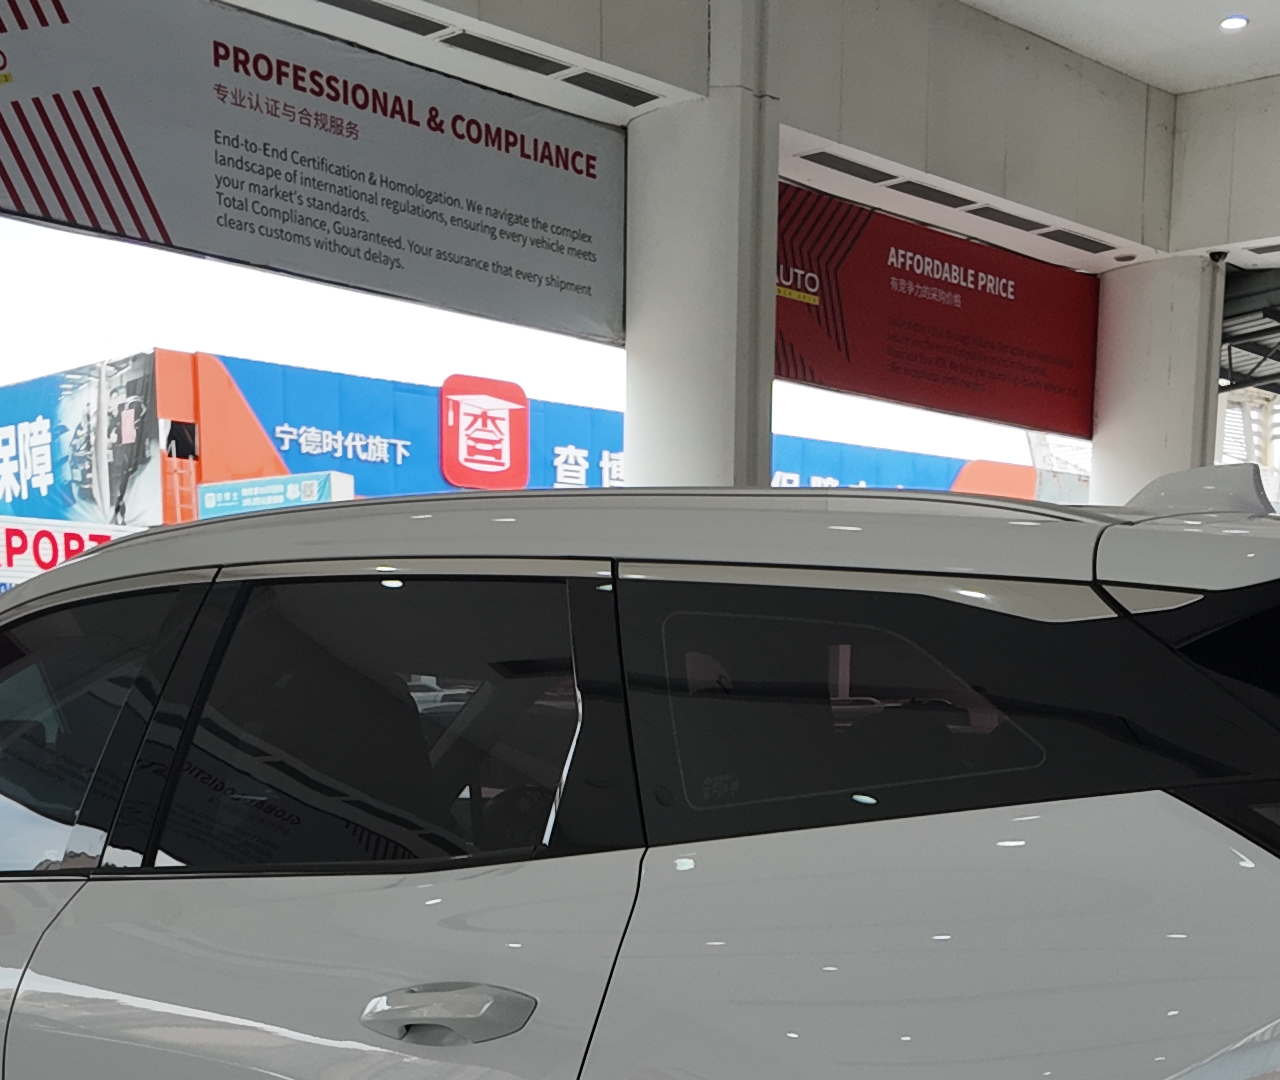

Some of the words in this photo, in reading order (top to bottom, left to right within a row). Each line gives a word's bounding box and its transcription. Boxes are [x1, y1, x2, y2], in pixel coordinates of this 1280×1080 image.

[213, 40, 420, 127] PROFESSIONAL
[426, 106, 445, 134] &
[451, 114, 597, 179] COMPLIANCE
[213, 82, 360, 141] 专业认证与合规服务
[214, 129, 288, 162] End-to-End
[291, 150, 365, 183] Certification
[367, 171, 378, 186] &
[380, 174, 464, 210] Homologation.
[465, 198, 483, 214] We
[485, 206, 530, 229] navigate
[531, 216, 549, 233] the
[550, 223, 593, 244] complex
[214, 149, 282, 181] landscape
[284, 170, 298, 183] of
[300, 172, 378, 206] international
[381, 196, 448, 227] regulations,
[450, 214, 498, 240] ensuring
[499, 228, 528, 248] every
[529, 235, 565, 255] vehicle
[567, 246, 597, 263] meets
[215, 174, 245, 190] your
[249, 181, 304, 206] market's
[306, 195, 370, 223] standards.
[215, 191, 248, 213] Total
[251, 200, 331, 235] Compliance,
[333, 221, 405, 251] Guaranteed.
[406, 239, 433, 258] Your
[435, 248, 490, 272] assurance
[491, 261, 513, 278] that
[515, 268, 544, 287] every
[545, 274, 592, 297] shipment
[216, 213, 256, 234] clears
[258, 225, 312, 248] customs
[314, 237, 362, 260] without
[363, 248, 405, 270] delays.
[887, 246, 975, 291] AFFORDABLE
[977, 270, 1016, 300] PRICE
[274, 422, 412, 466] 宁德时代旗下
